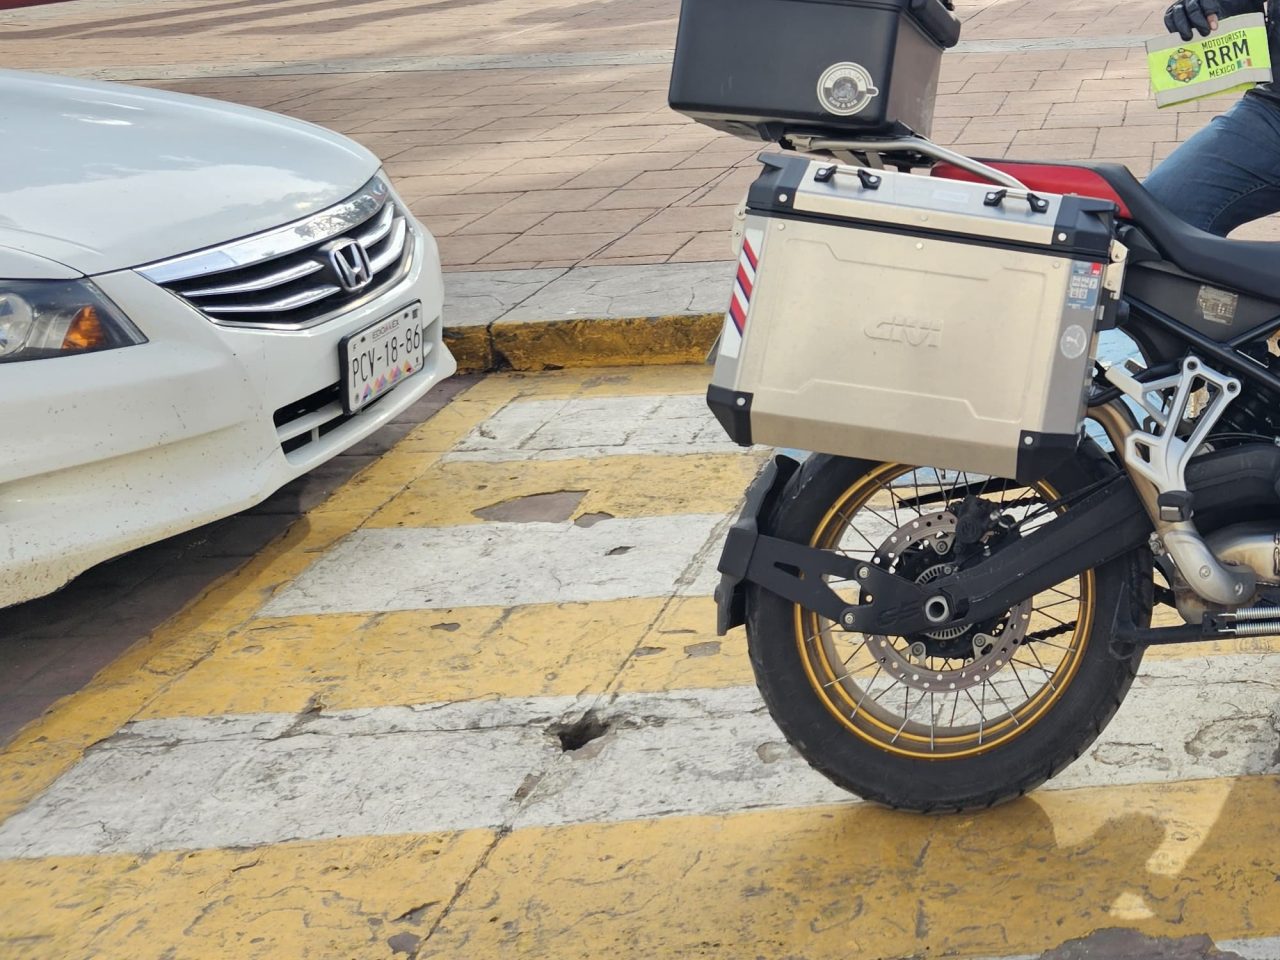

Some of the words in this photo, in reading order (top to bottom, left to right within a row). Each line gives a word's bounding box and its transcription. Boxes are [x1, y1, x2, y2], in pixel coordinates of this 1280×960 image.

[1201, 30, 1247, 50] MOTOTURISTA
[1204, 38, 1250, 69] RRM
[352, 323, 421, 389] PCV-18-86
